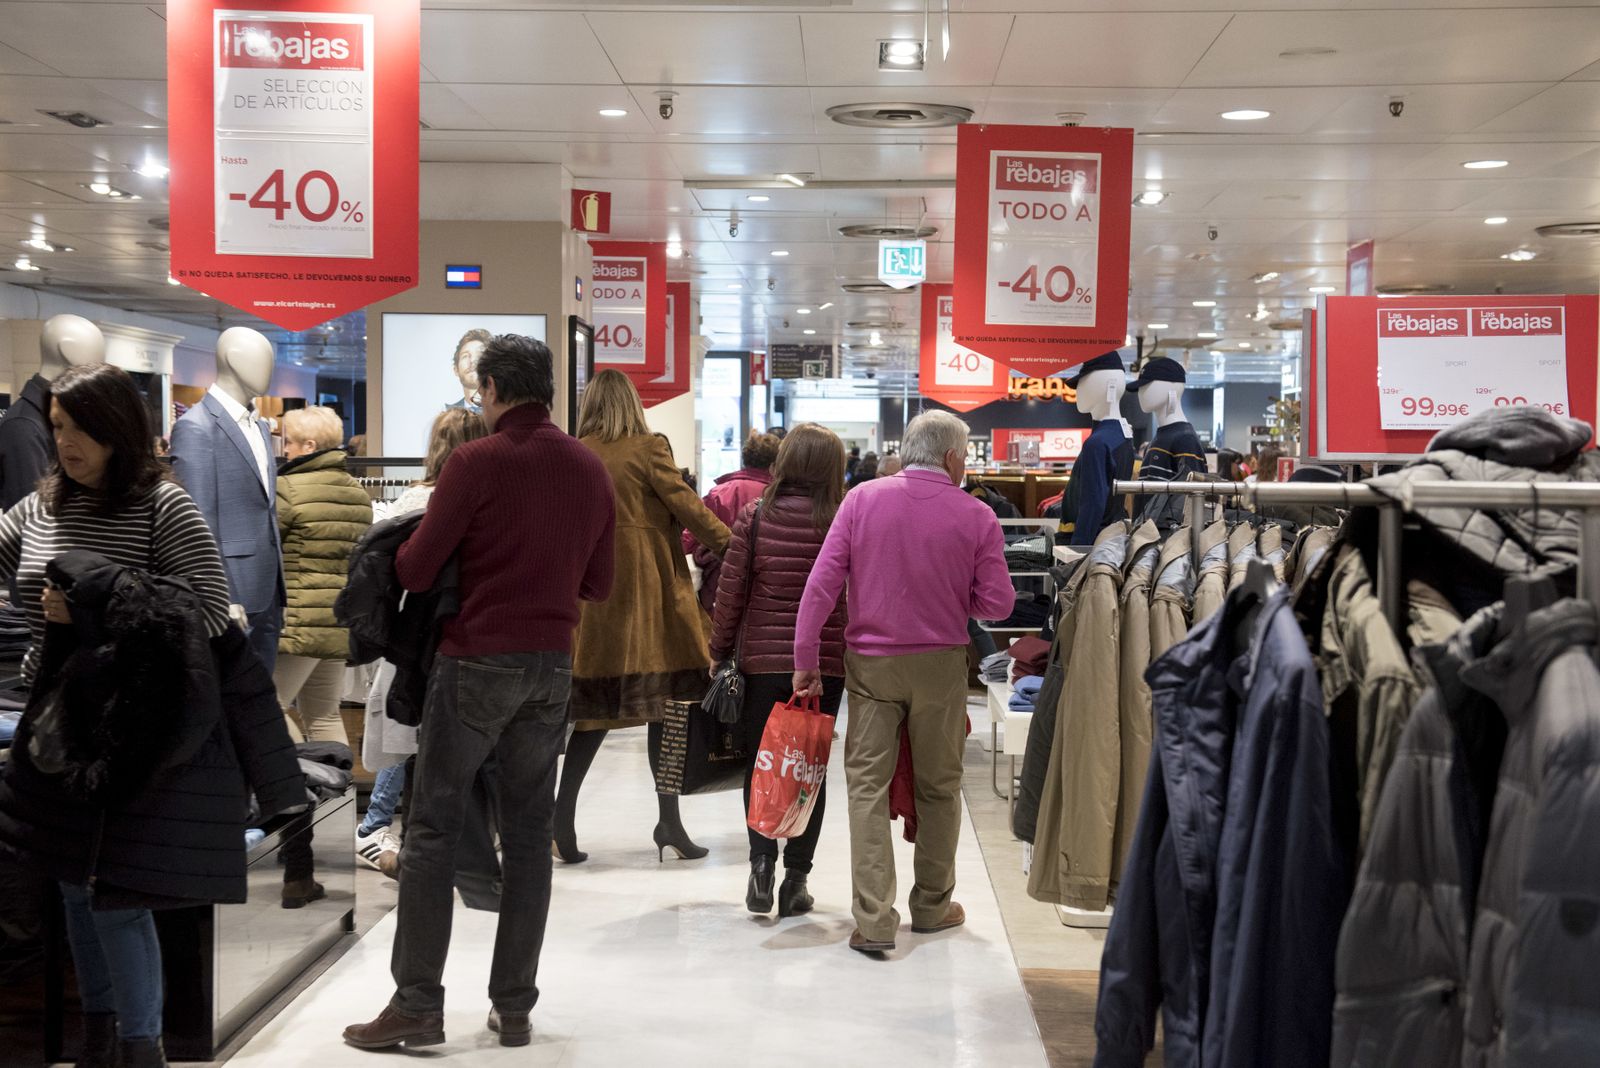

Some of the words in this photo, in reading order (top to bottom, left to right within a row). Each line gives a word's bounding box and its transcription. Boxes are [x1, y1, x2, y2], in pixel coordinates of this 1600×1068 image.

[233, 24, 256, 35] Las
[233, 30, 350, 64] rebajas
[234, 95, 257, 109] DE
[264, 94, 363, 111] ARTÍCULOS
[221, 156, 248, 165] Hasta
[1006, 158, 1023, 167] Las
[1006, 163, 1087, 188] rebajas
[229, 169, 364, 223] -40%
[998, 201, 1067, 221] TODO
[1075, 204, 1092, 222] A
[204, 270, 233, 278] QUEDA
[379, 275, 412, 283] DINERO
[592, 263, 638, 279] ebajas
[998, 264, 1092, 304] -40%
[592, 287, 626, 299] ODO
[631, 288, 642, 299] A
[253, 300, 336, 309] www.elcorteingles.es
[1387, 314, 1459, 334] rebajas
[1480, 313, 1553, 333] rebajas
[1400, 397, 1470, 418] 99,99€
[784, 745, 803, 759] Las
